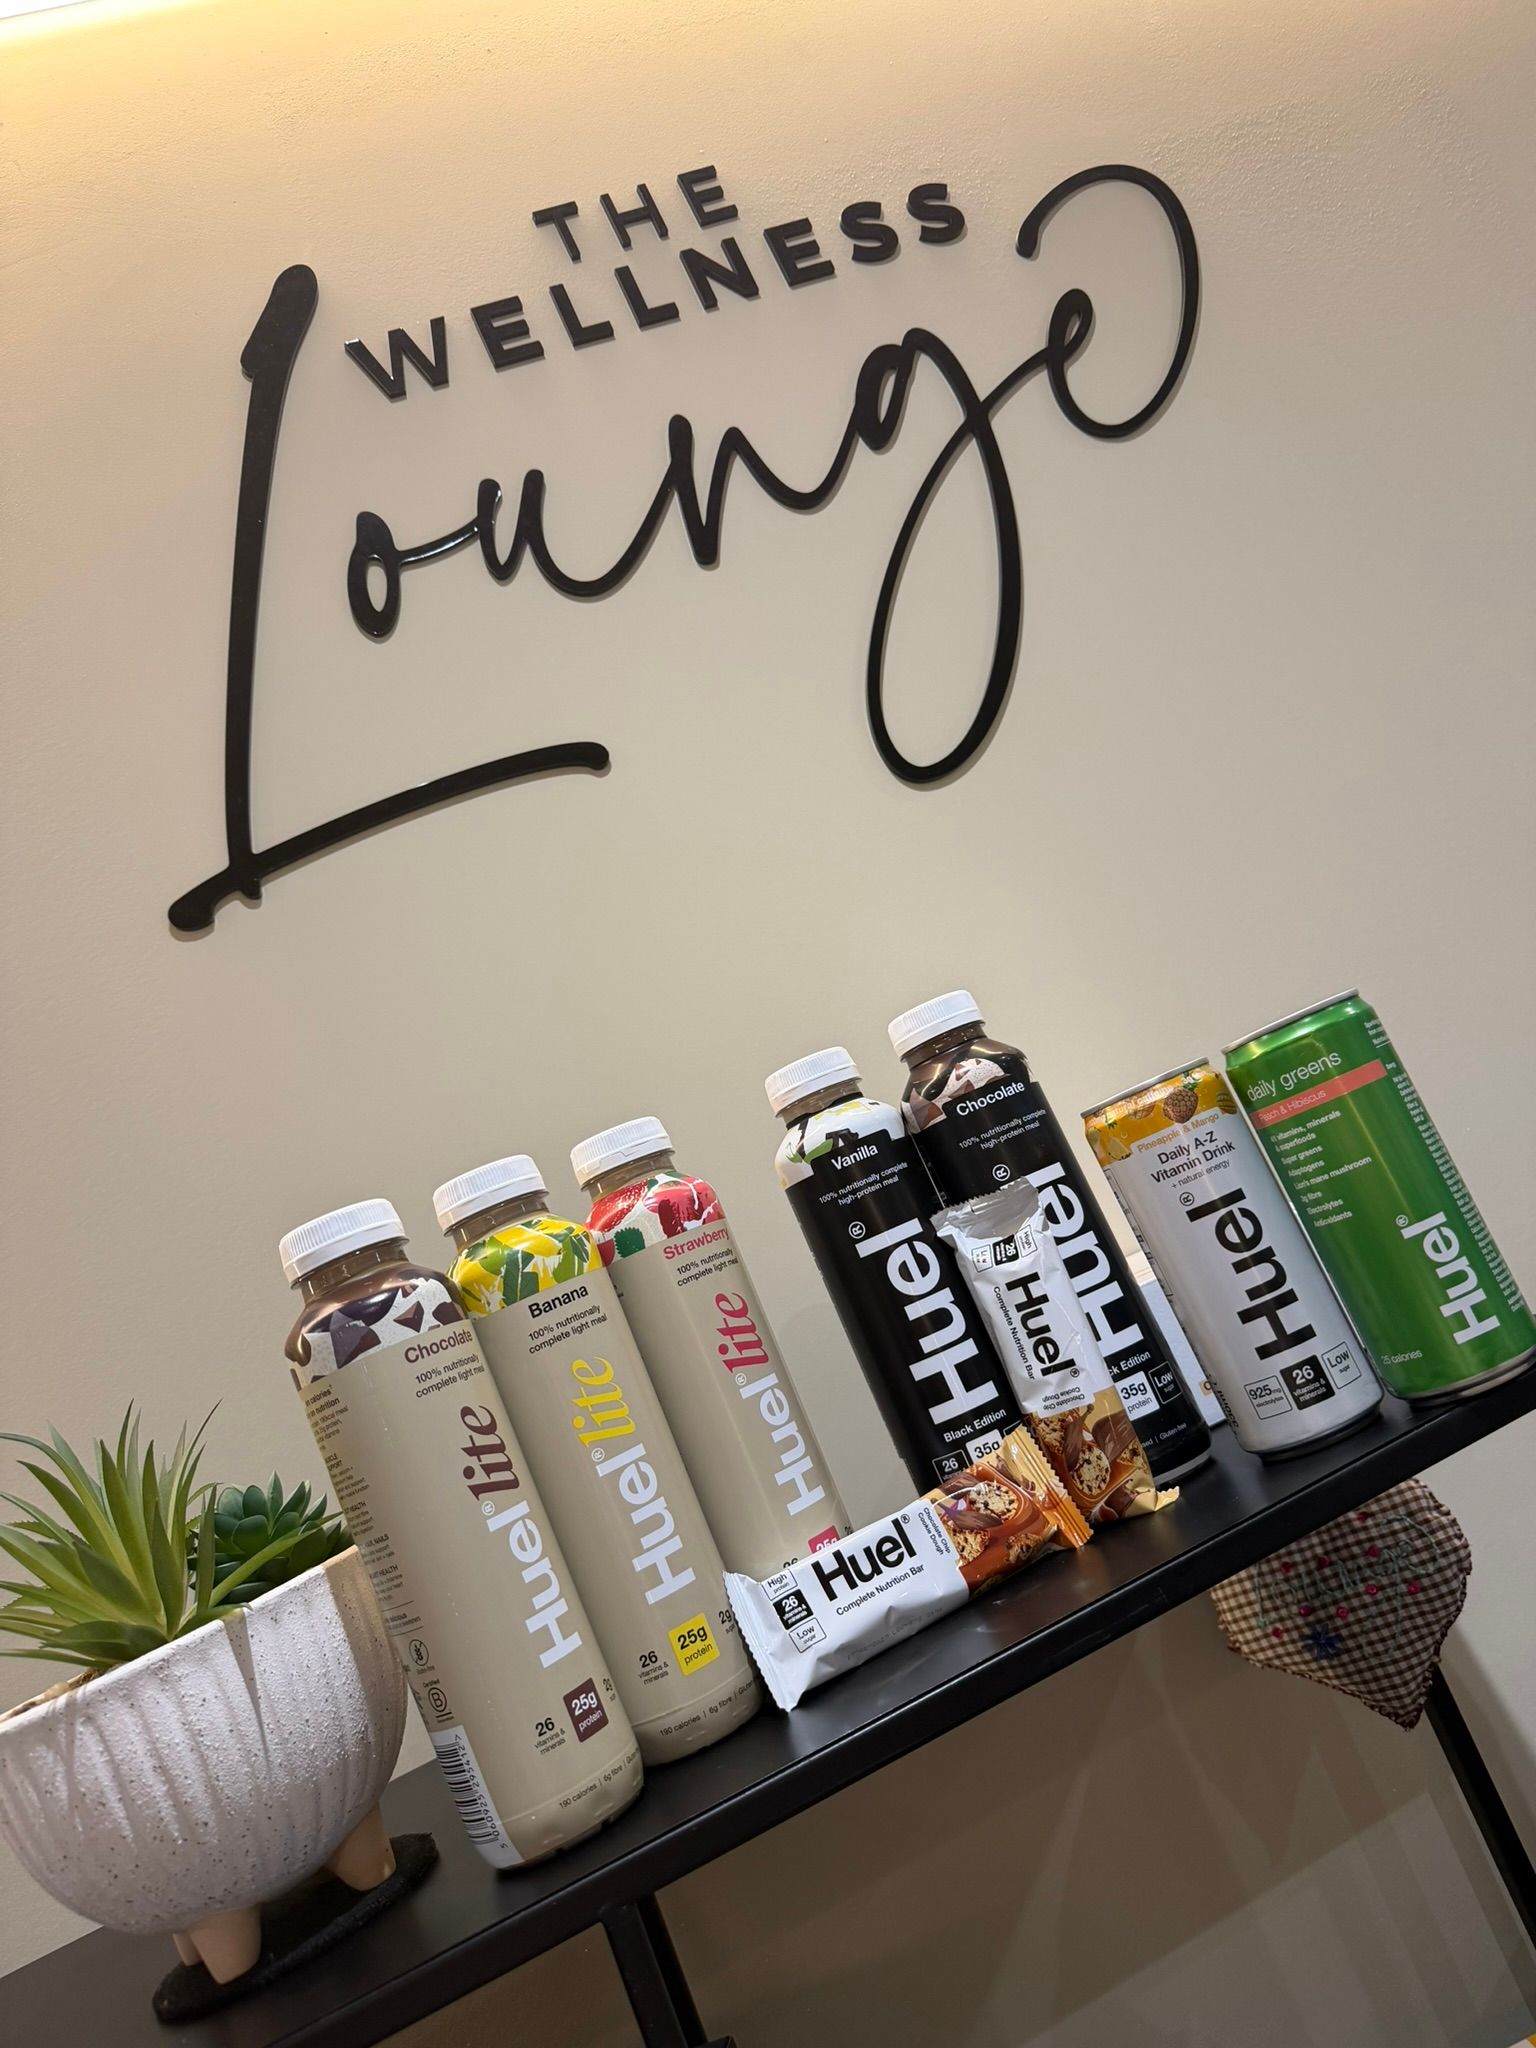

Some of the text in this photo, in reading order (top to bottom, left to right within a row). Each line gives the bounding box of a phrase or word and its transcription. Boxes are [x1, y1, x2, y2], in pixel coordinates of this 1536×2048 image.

[532, 165, 739, 262] THE
[344, 182, 966, 401] WELLNESS
[167, 163, 1200, 936] Lounge
[1246, 1052, 1342, 1102] daily greens
[956, 1081, 1025, 1116] Chocolate
[1287, 1089, 1327, 1112] Hibiscus
[1306, 1110, 1341, 1129] minerals
[959, 1135, 980, 1149] 100%
[980, 1118, 1022, 1141] nutritionally
[980, 1127, 1025, 1150] high-protein
[1137, 1113, 1220, 1153] Pineapple & Mango
[831, 1144, 878, 1171] Vanilla
[1157, 1130, 1218, 1165] Daily A-Z
[1298, 1145, 1323, 1161] greens
[1150, 1141, 1236, 1184] Vitamin Drink
[1178, 1170, 1205, 1187] natural
[1206, 1159, 1231, 1175] energy
[1329, 1156, 1372, 1178] mushroom
[819, 1162, 908, 1204] 100% nutritionally complete
[838, 1175, 899, 1207] high-protein meal
[663, 1227, 730, 1260] Strawberry
[1005, 1242, 1017, 1256] 26
[676, 1260, 700, 1275] 100%
[677, 1266, 713, 1287] complete
[713, 1261, 728, 1273] light
[528, 1285, 589, 1319] Banana
[528, 1304, 601, 1341] 100% nutritionally
[529, 1313, 608, 1354] complete light meal
[715, 1292, 770, 1374] lite
[993, 1286, 1035, 1380] Complete Nutrition Bar
[404, 1329, 473, 1364] Chocolate
[1327, 1350, 1350, 1368] Low
[1119, 1351, 1151, 1371] Edition
[415, 1367, 442, 1385] 100%
[415, 1374, 458, 1398] complete
[457, 1368, 474, 1381] light
[1154, 1370, 1174, 1388] Low
[1292, 1365, 1314, 1385] 26
[571, 1356, 636, 1448] lite
[1043, 1393, 1085, 1411] Chocolate Chip
[1060, 1386, 1081, 1397] Cookie
[1120, 1381, 1148, 1401] 35g
[1127, 1396, 1154, 1414] protein
[943, 1408, 1007, 1443] Black Edition
[460, 1404, 521, 1501] lite
[942, 1457, 959, 1473] 26
[918, 1512, 944, 1555] Cookie Dough
[923, 1507, 951, 1554] Chocolate Chip
[767, 1572, 787, 1589] High
[836, 1562, 925, 1616] Complete Nutrition Bar
[782, 1595, 799, 1612] 26
[718, 1609, 732, 1625] 2g
[677, 1625, 708, 1651] 25g
[796, 1625, 815, 1640] Low
[639, 1650, 659, 1669] 26
[684, 1642, 713, 1666] protein
[572, 1691, 598, 1716] 25g
[535, 1717, 555, 1737] 26
[578, 1709, 604, 1733] protein
[659, 1727, 673, 1738] 190
[673, 1714, 701, 1732] calories
[559, 1797, 572, 1810] 190
[572, 1783, 598, 1802] calories
